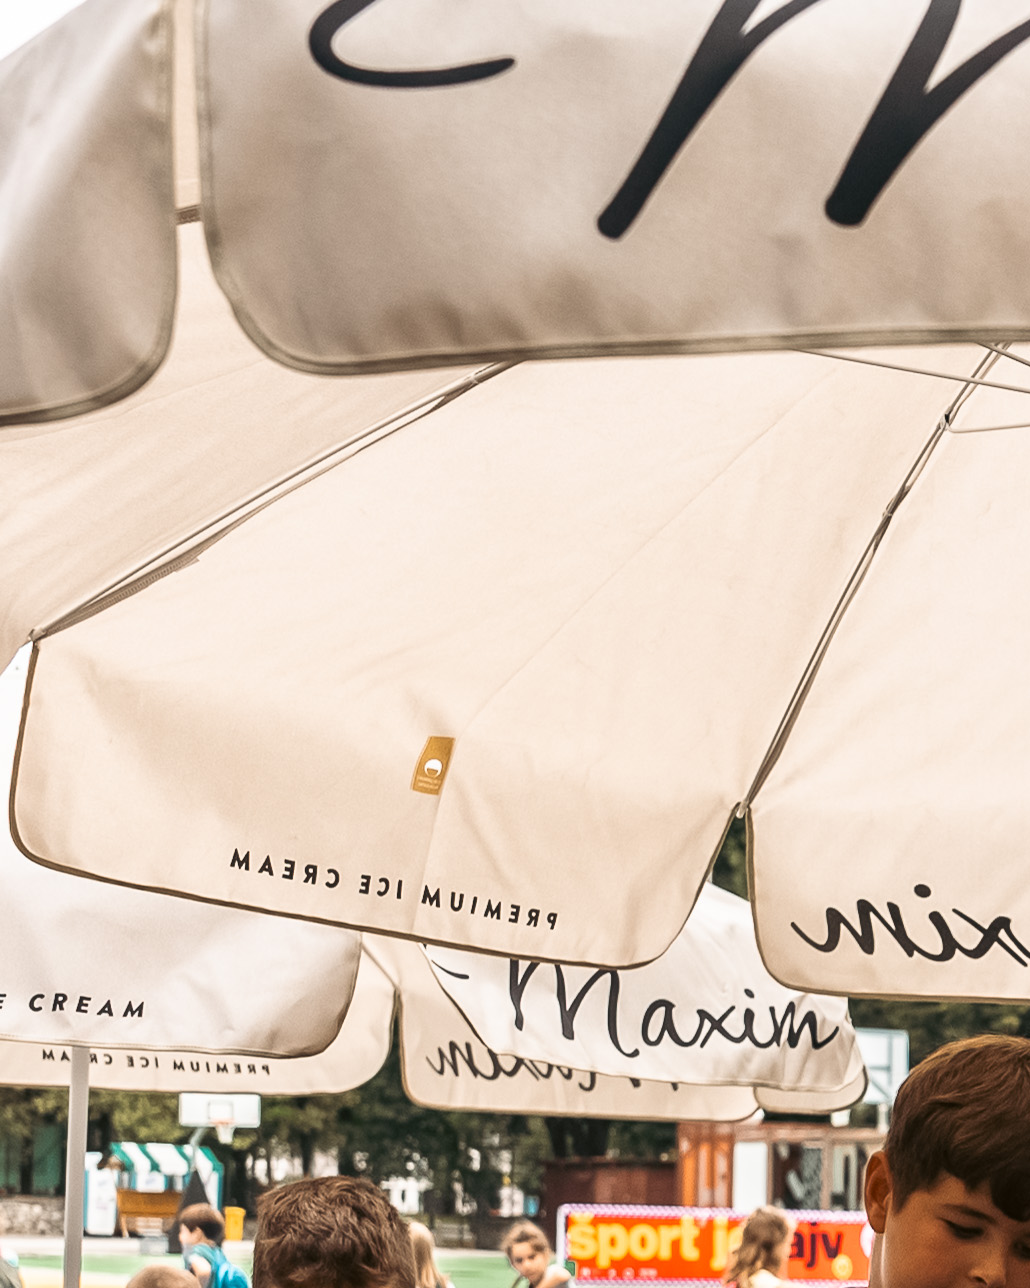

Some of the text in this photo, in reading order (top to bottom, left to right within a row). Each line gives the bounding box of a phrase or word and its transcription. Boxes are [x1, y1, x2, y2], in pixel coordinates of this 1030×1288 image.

[28, 993, 146, 1018] CREAM
[430, 958, 839, 1058] Maxim
[568, 1212, 699, 1269] šport
